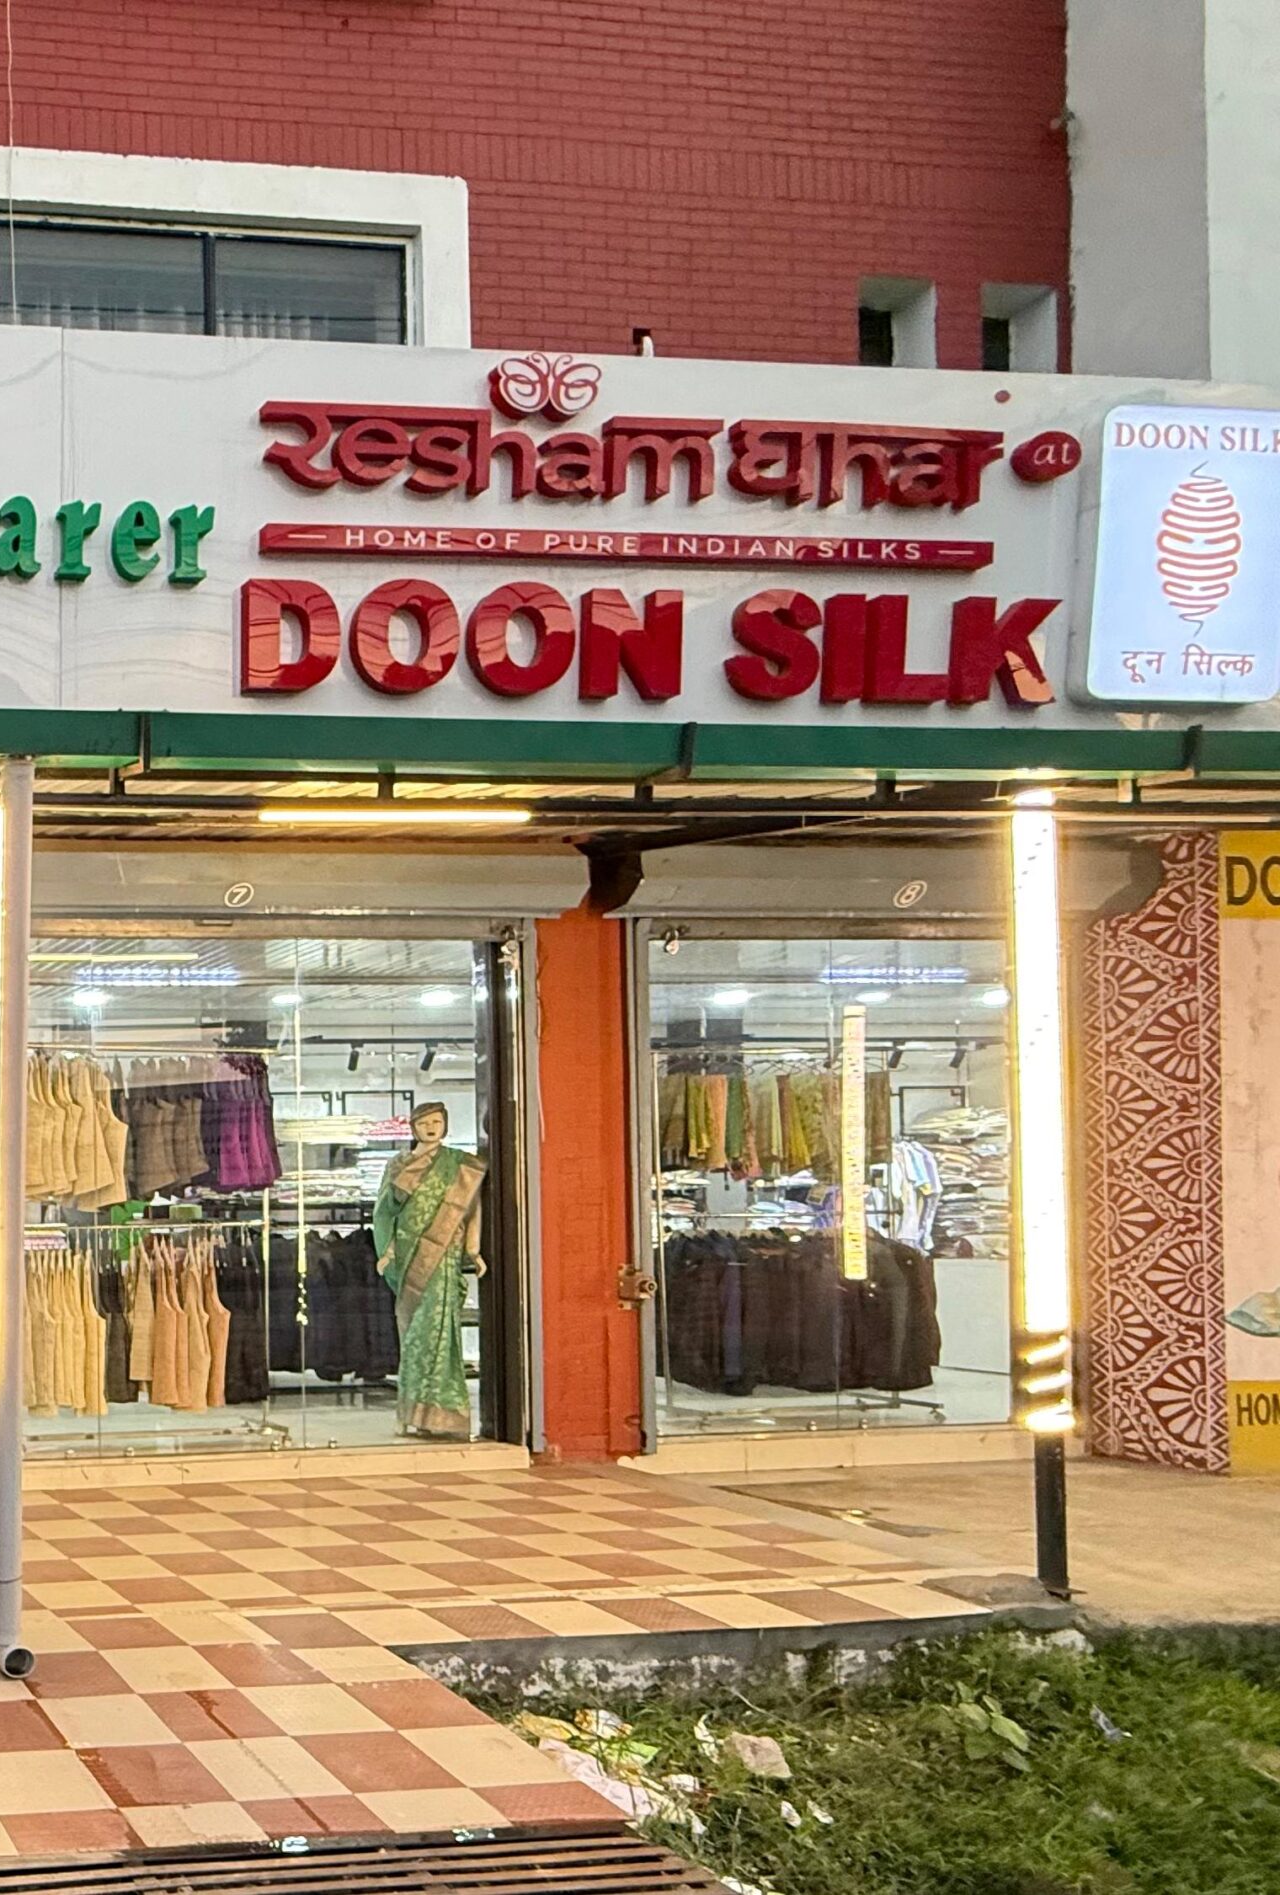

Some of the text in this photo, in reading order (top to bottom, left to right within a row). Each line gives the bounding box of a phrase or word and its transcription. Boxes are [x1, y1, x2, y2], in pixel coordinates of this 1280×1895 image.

[1115, 421, 1210, 451] DOON
[345, 528, 921, 561] HOME OF PURE INDIAN SILKS
[240, 577, 1064, 708] DOON SILK
[1121, 644, 1255, 683] दून सिल्क
